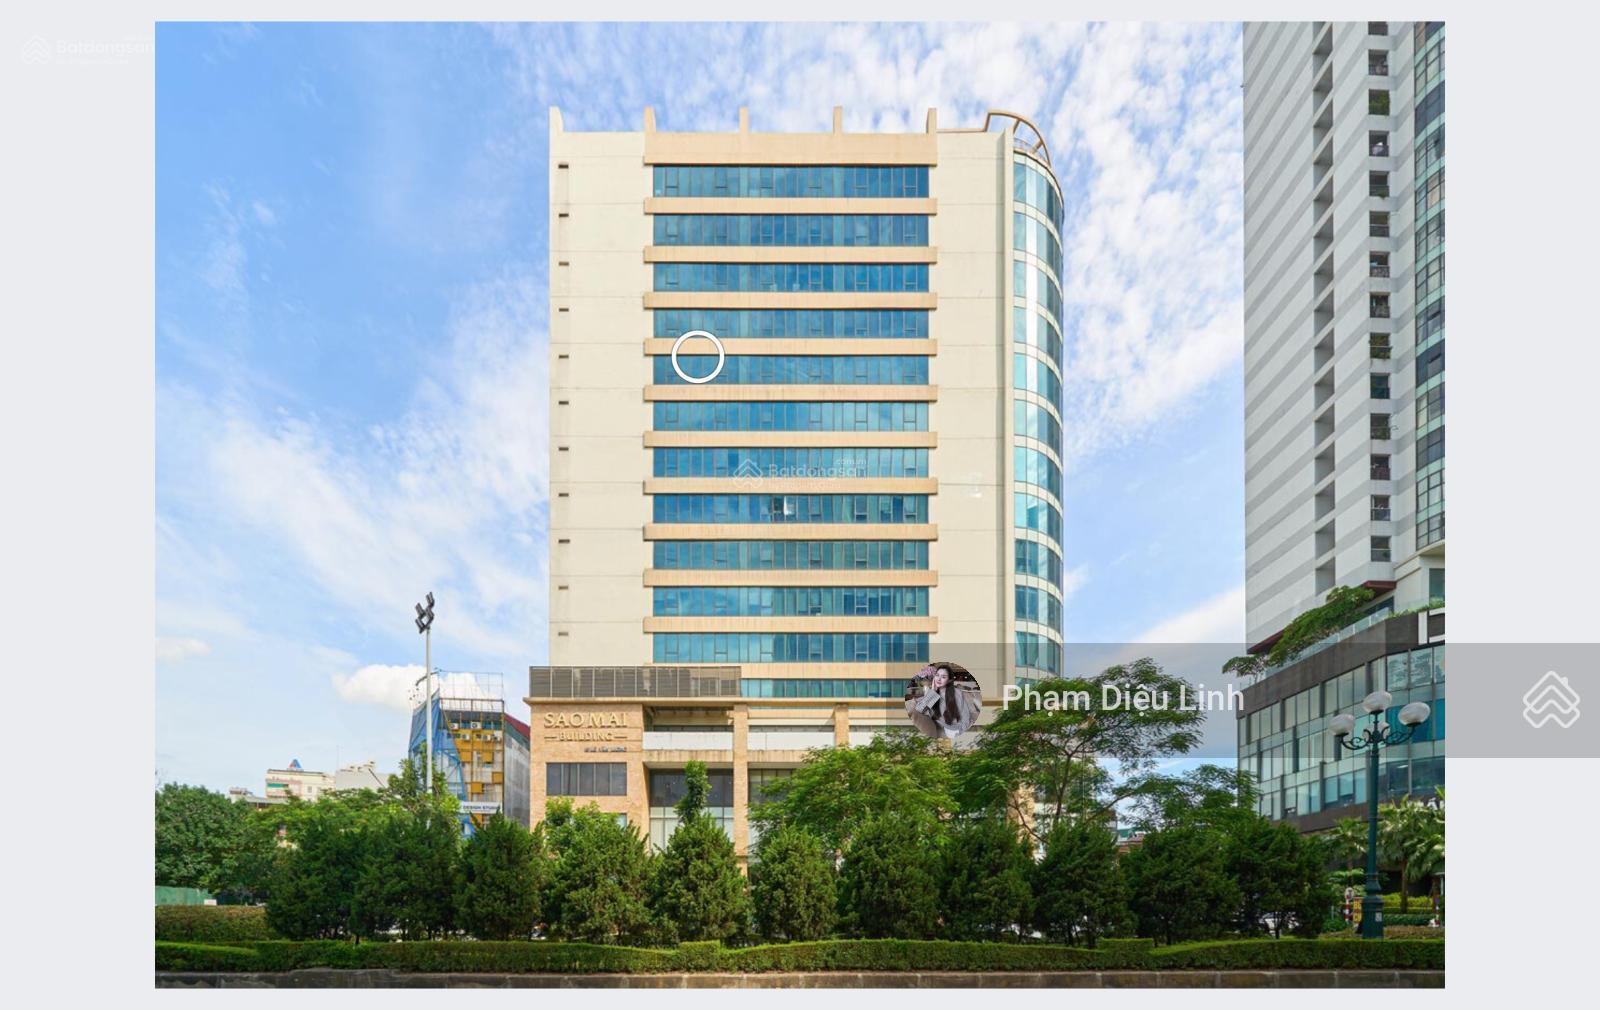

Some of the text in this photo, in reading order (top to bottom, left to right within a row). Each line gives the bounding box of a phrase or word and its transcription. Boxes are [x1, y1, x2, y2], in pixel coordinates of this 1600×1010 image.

[544, 712, 628, 728] SAO MAI
[558, 731, 613, 742] BUILDING
